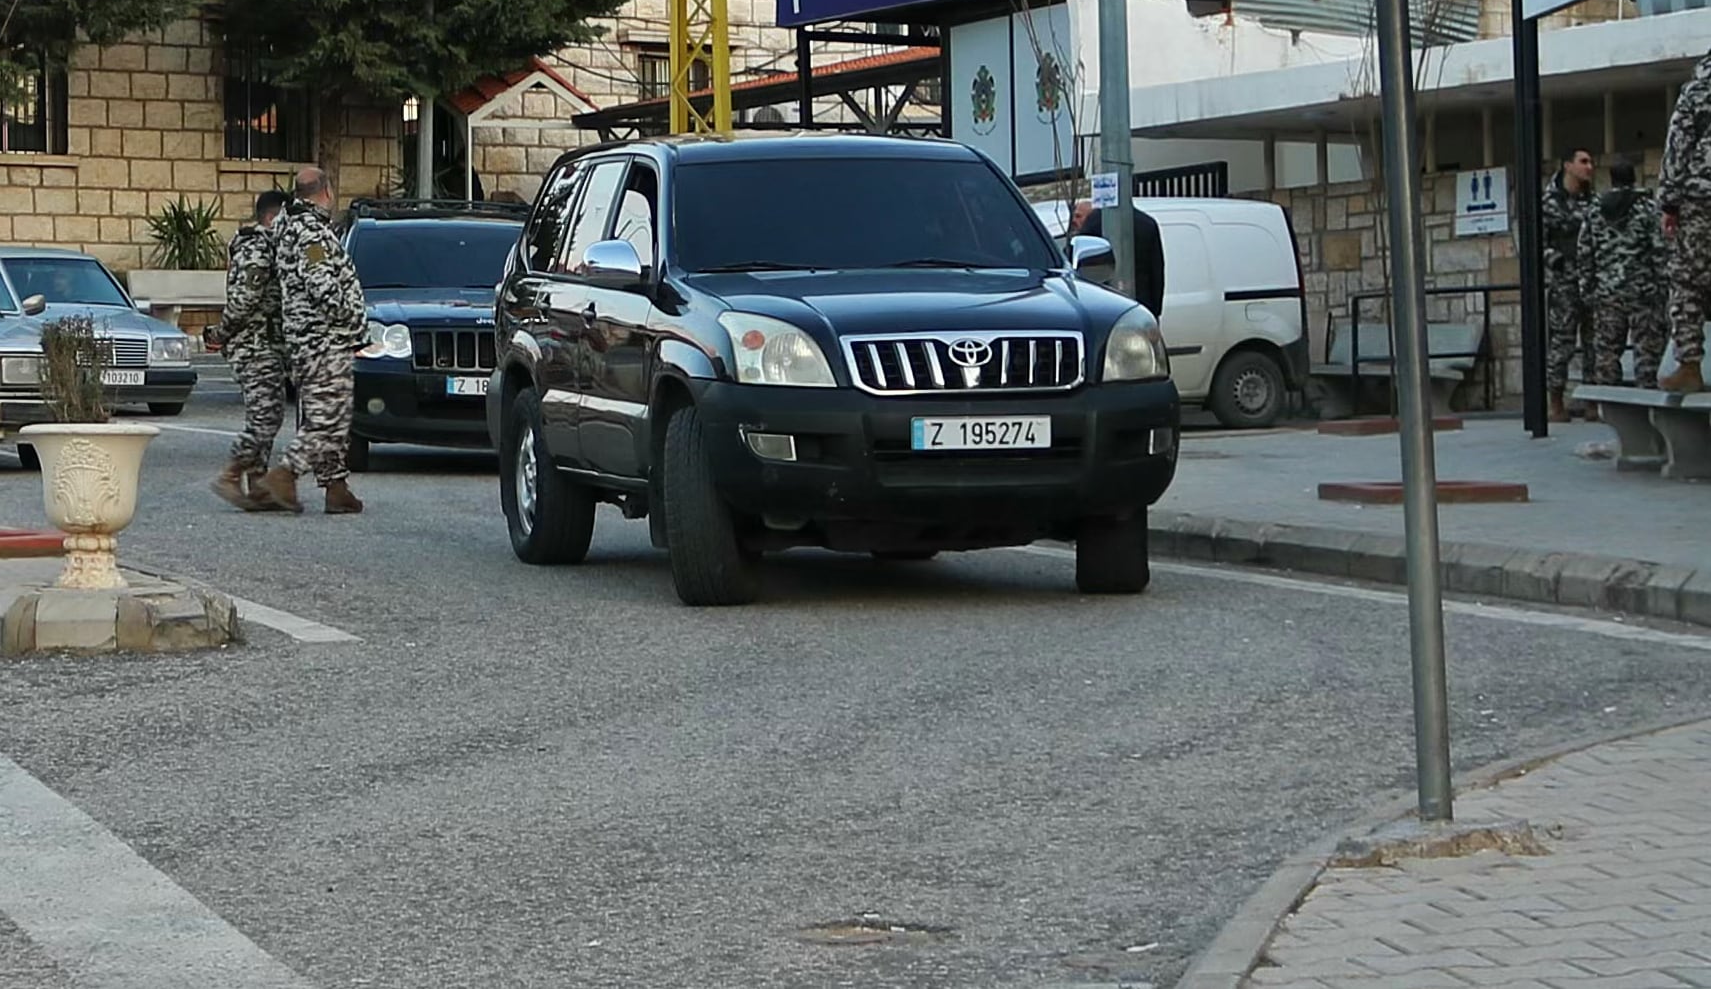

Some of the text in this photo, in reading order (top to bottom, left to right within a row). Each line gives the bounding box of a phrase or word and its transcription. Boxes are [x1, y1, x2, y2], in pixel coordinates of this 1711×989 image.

[458, 379, 466, 393] Z
[930, 421, 1036, 446] Z 195274
